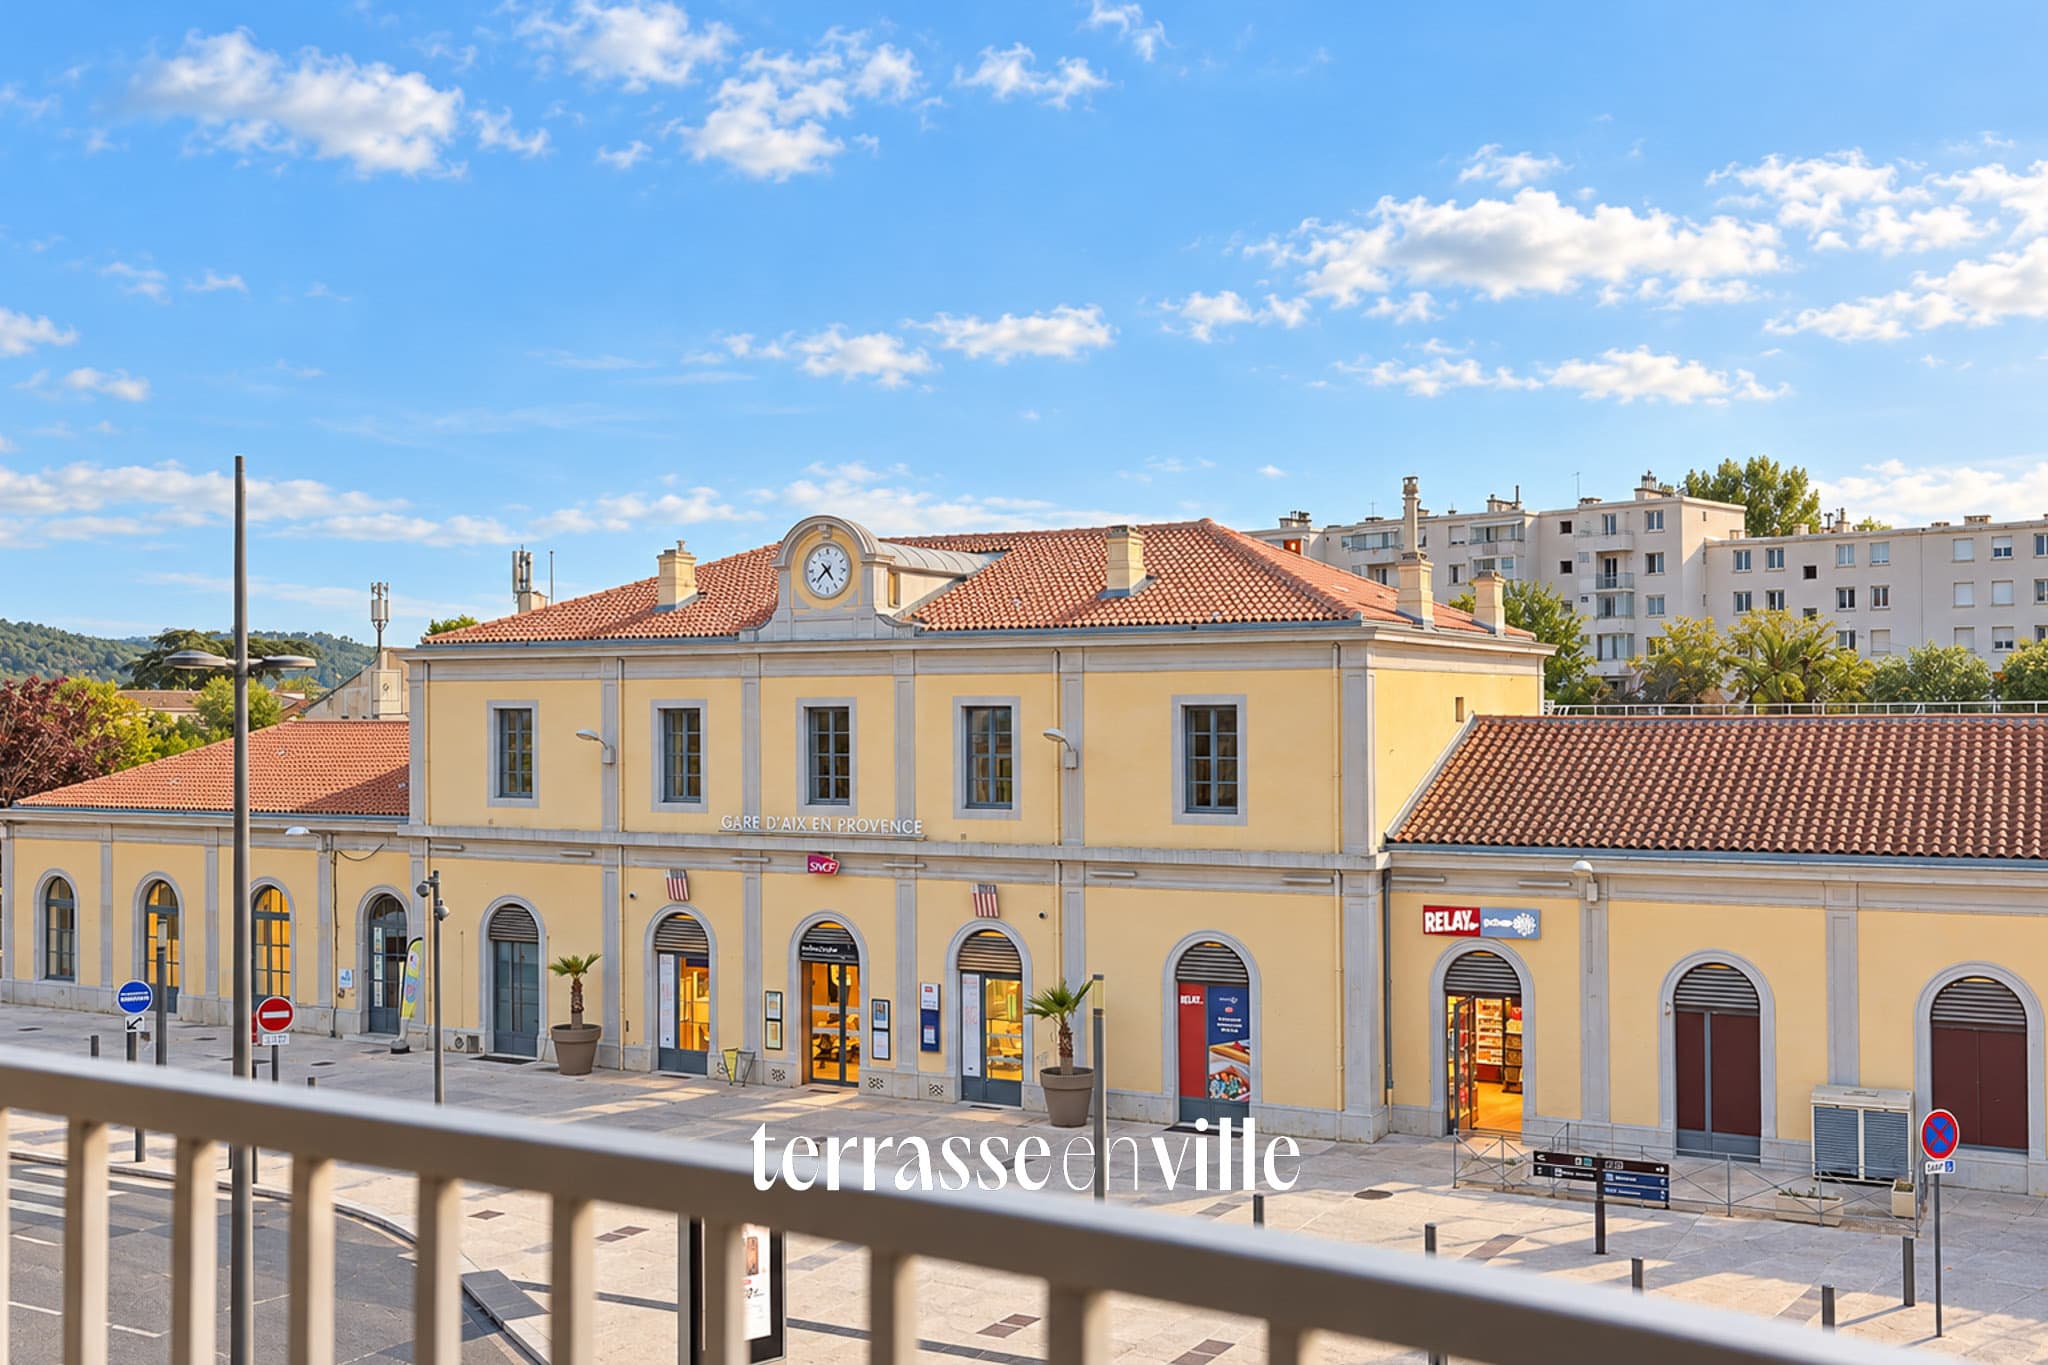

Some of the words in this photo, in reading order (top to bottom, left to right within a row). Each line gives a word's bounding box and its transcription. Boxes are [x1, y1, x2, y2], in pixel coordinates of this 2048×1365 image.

[721, 815, 760, 830] GARE
[766, 816, 807, 831] D'AIX
[812, 816, 831, 832] EN
[837, 818, 923, 834] PROVENCE
[809, 861, 836, 873] SNCF
